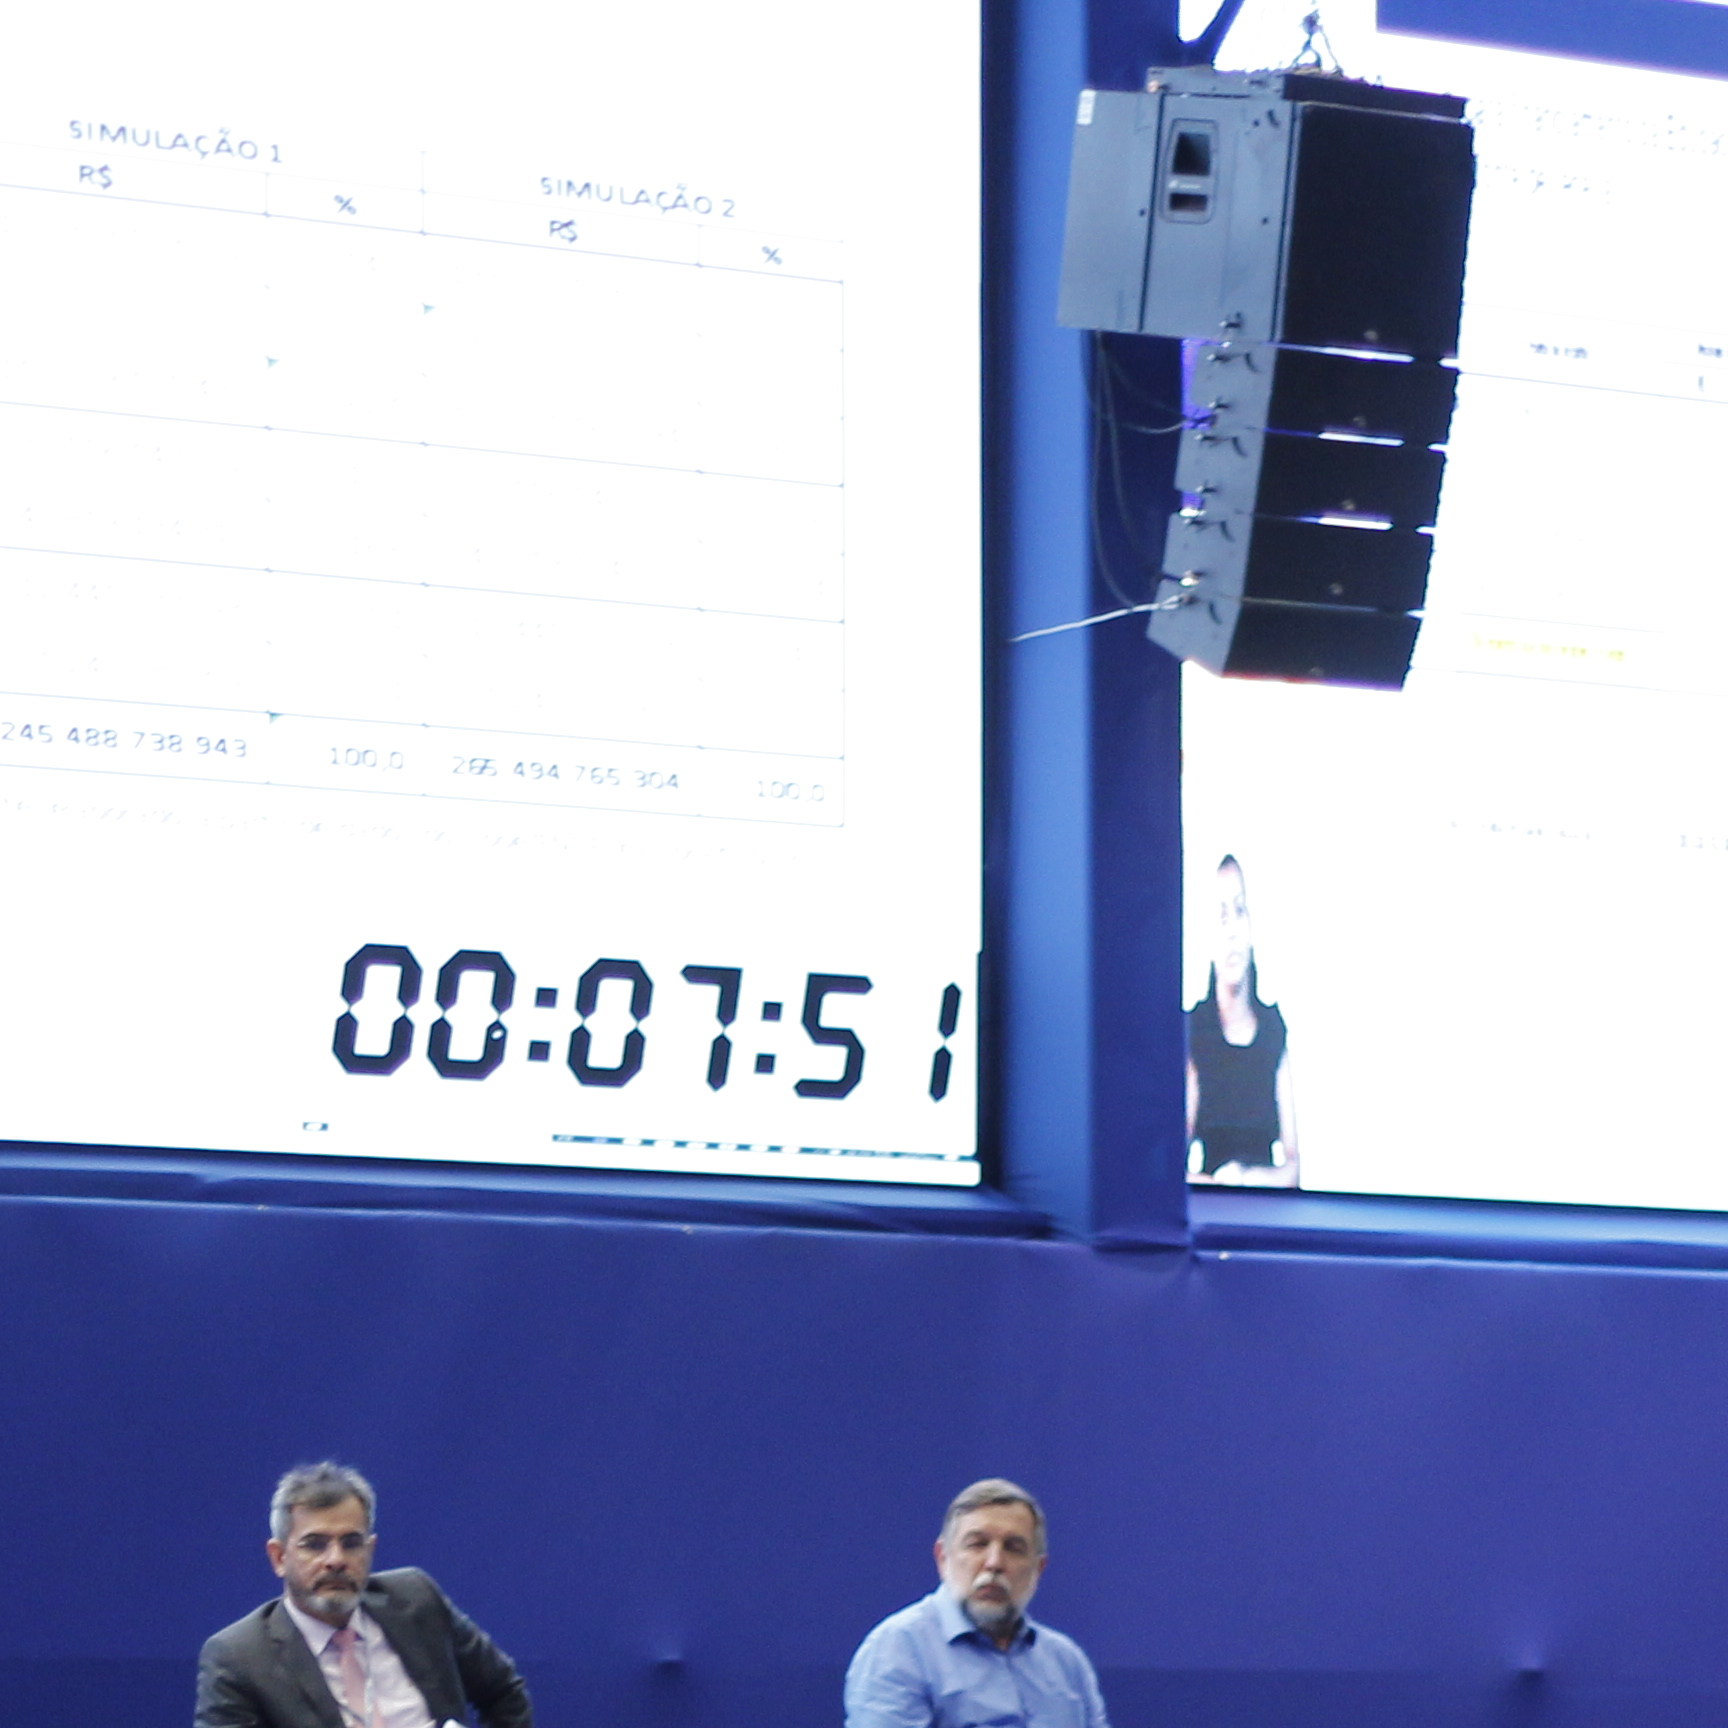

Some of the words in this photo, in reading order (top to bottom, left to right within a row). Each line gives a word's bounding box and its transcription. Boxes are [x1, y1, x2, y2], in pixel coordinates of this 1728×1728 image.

[67, 117, 260, 162] SIMULAÇÃO
[269, 142, 283, 165] 1
[77, 162, 115, 192] R$
[332, 193, 359, 217] %
[538, 174, 714, 217] SIMULAÇÃO
[720, 196, 737, 220] 2
[0, 720, 55, 745] 245
[65, 725, 119, 750] 488
[194, 734, 248, 759] 943
[511, 759, 561, 782] 494
[575, 763, 622, 788] 765
[634, 768, 681, 791] 304
[332, 943, 962, 1103] 00:07:51
